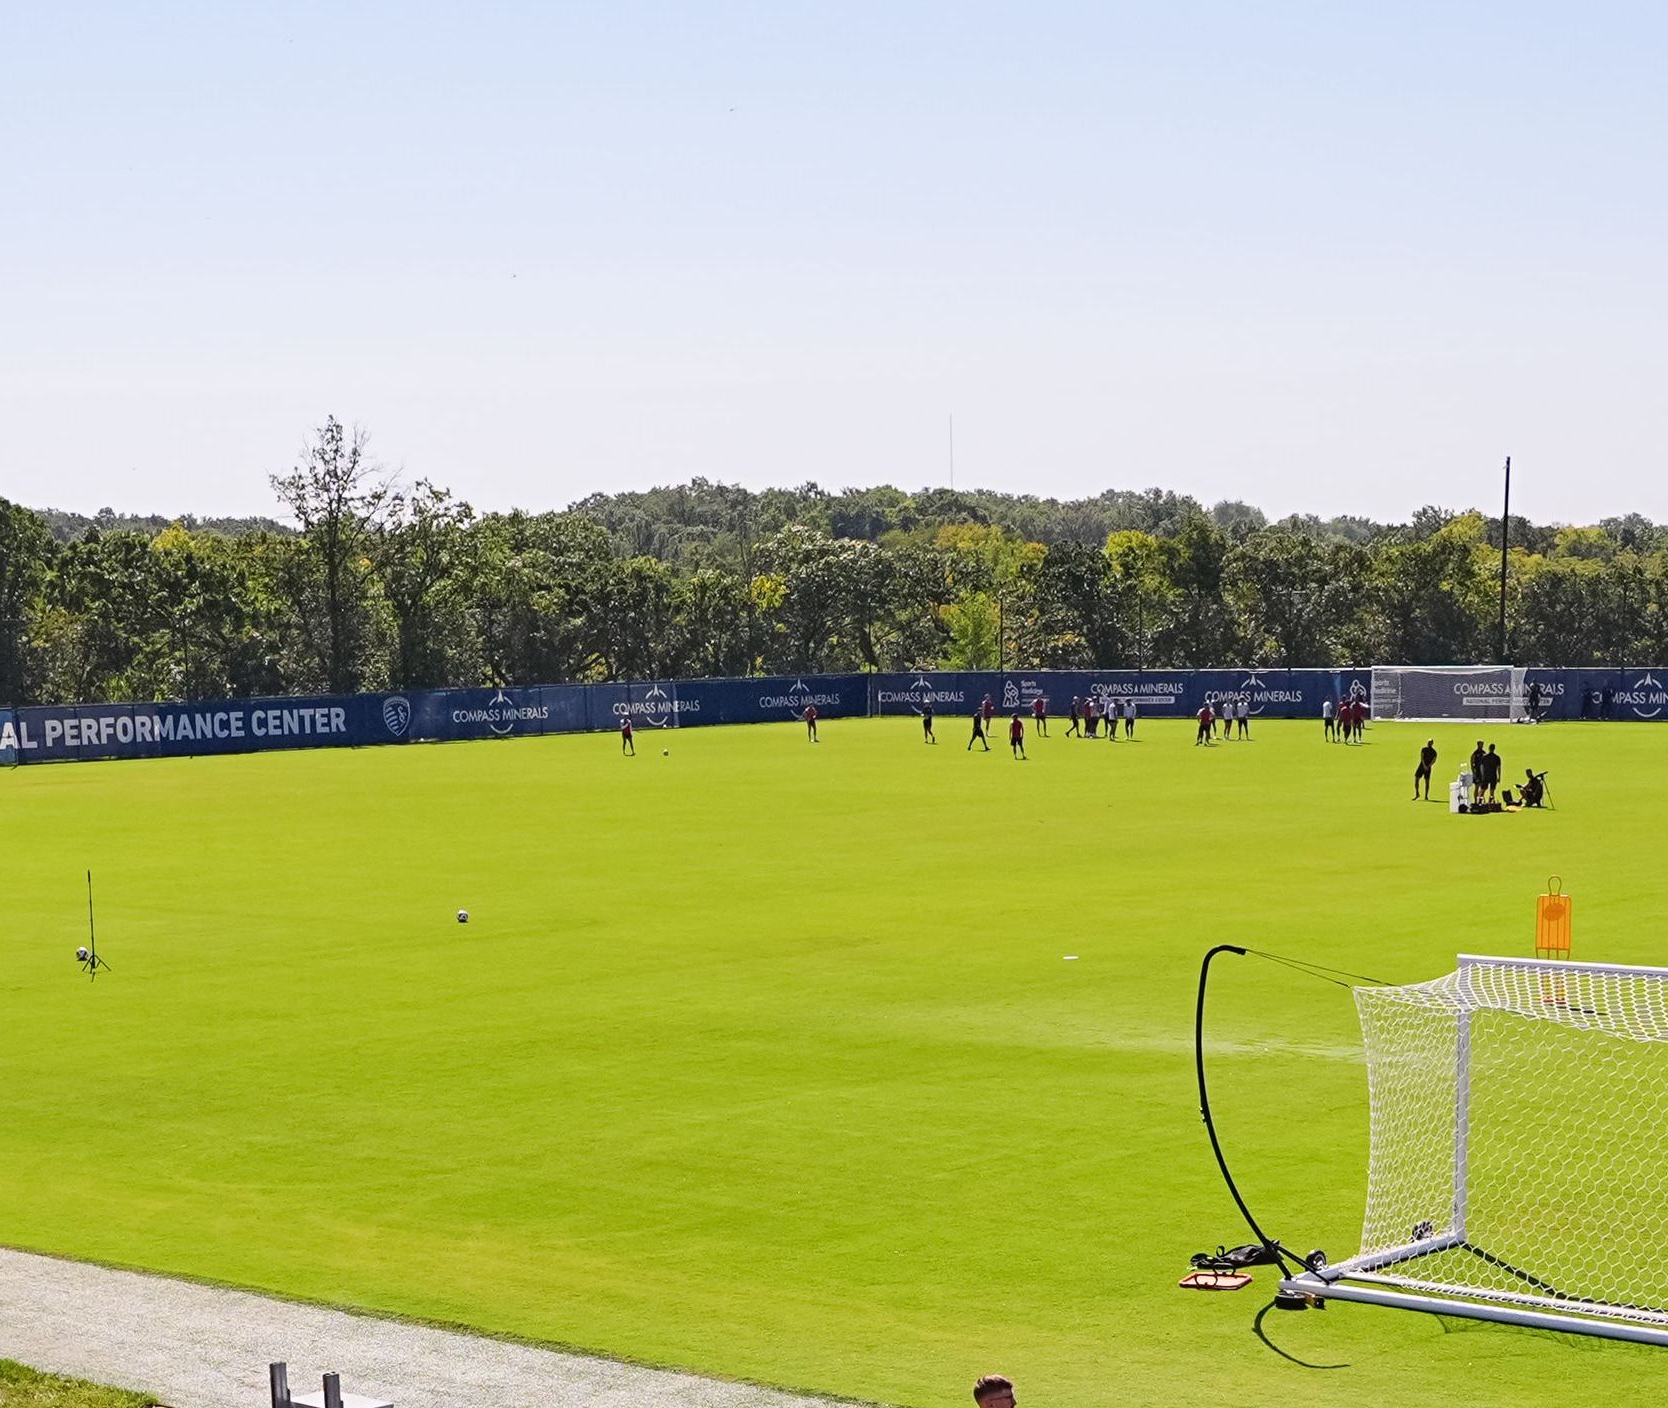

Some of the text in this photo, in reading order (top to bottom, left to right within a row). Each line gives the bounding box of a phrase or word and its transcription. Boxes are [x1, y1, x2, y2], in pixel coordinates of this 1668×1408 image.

[1090, 683, 1184, 694] COMPASS MINERALS
[1453, 683, 1504, 695] COMPASS
[759, 693, 841, 708] COMPASS MINERALS
[880, 691, 965, 702] COMPASS MINERALS
[1204, 690, 1302, 702] COMPASS MINERALS
[612, 699, 701, 715] COMPASS MINERALS
[452, 706, 549, 723] COMPASS MINERALS
[44, 710, 246, 747] PERFORMANCE
[251, 706, 347, 737] CENTER
